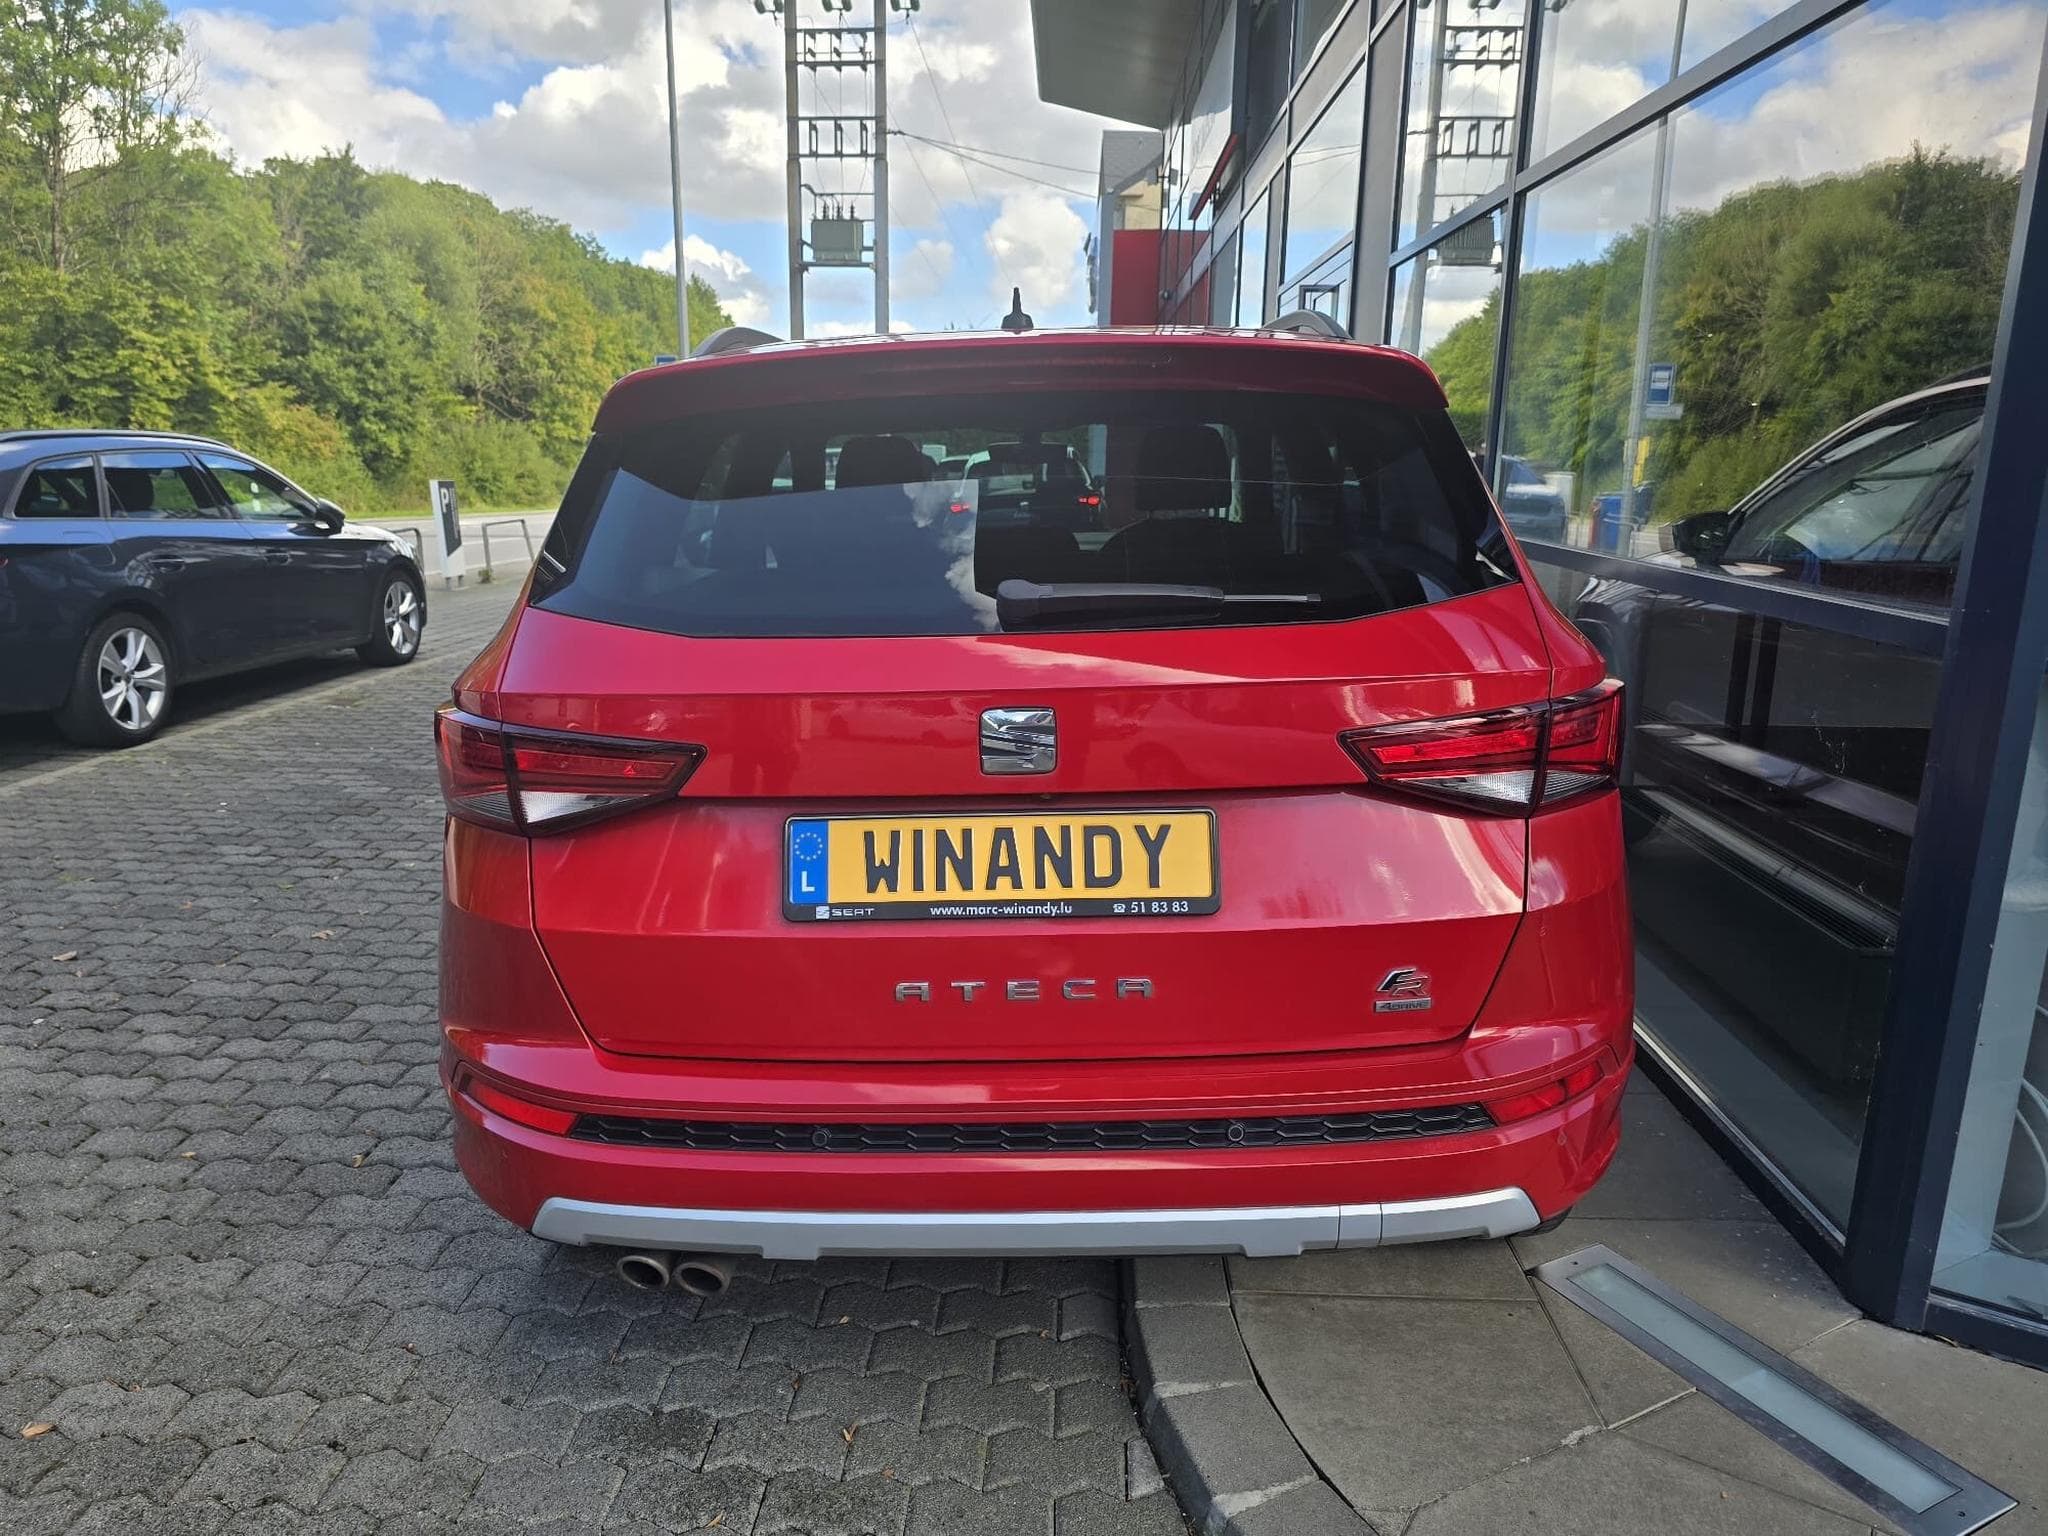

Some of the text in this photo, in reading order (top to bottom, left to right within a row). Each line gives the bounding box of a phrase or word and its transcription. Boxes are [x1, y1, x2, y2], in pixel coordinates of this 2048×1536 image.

[863, 823, 1172, 894] WINANDY
[801, 870, 816, 893] L
[831, 907, 875, 917] SEAT
[930, 901, 1073, 917] www.marc-winandy.lu
[1130, 900, 1189, 913] 51 83 83
[895, 978, 1153, 1002] ATECA
